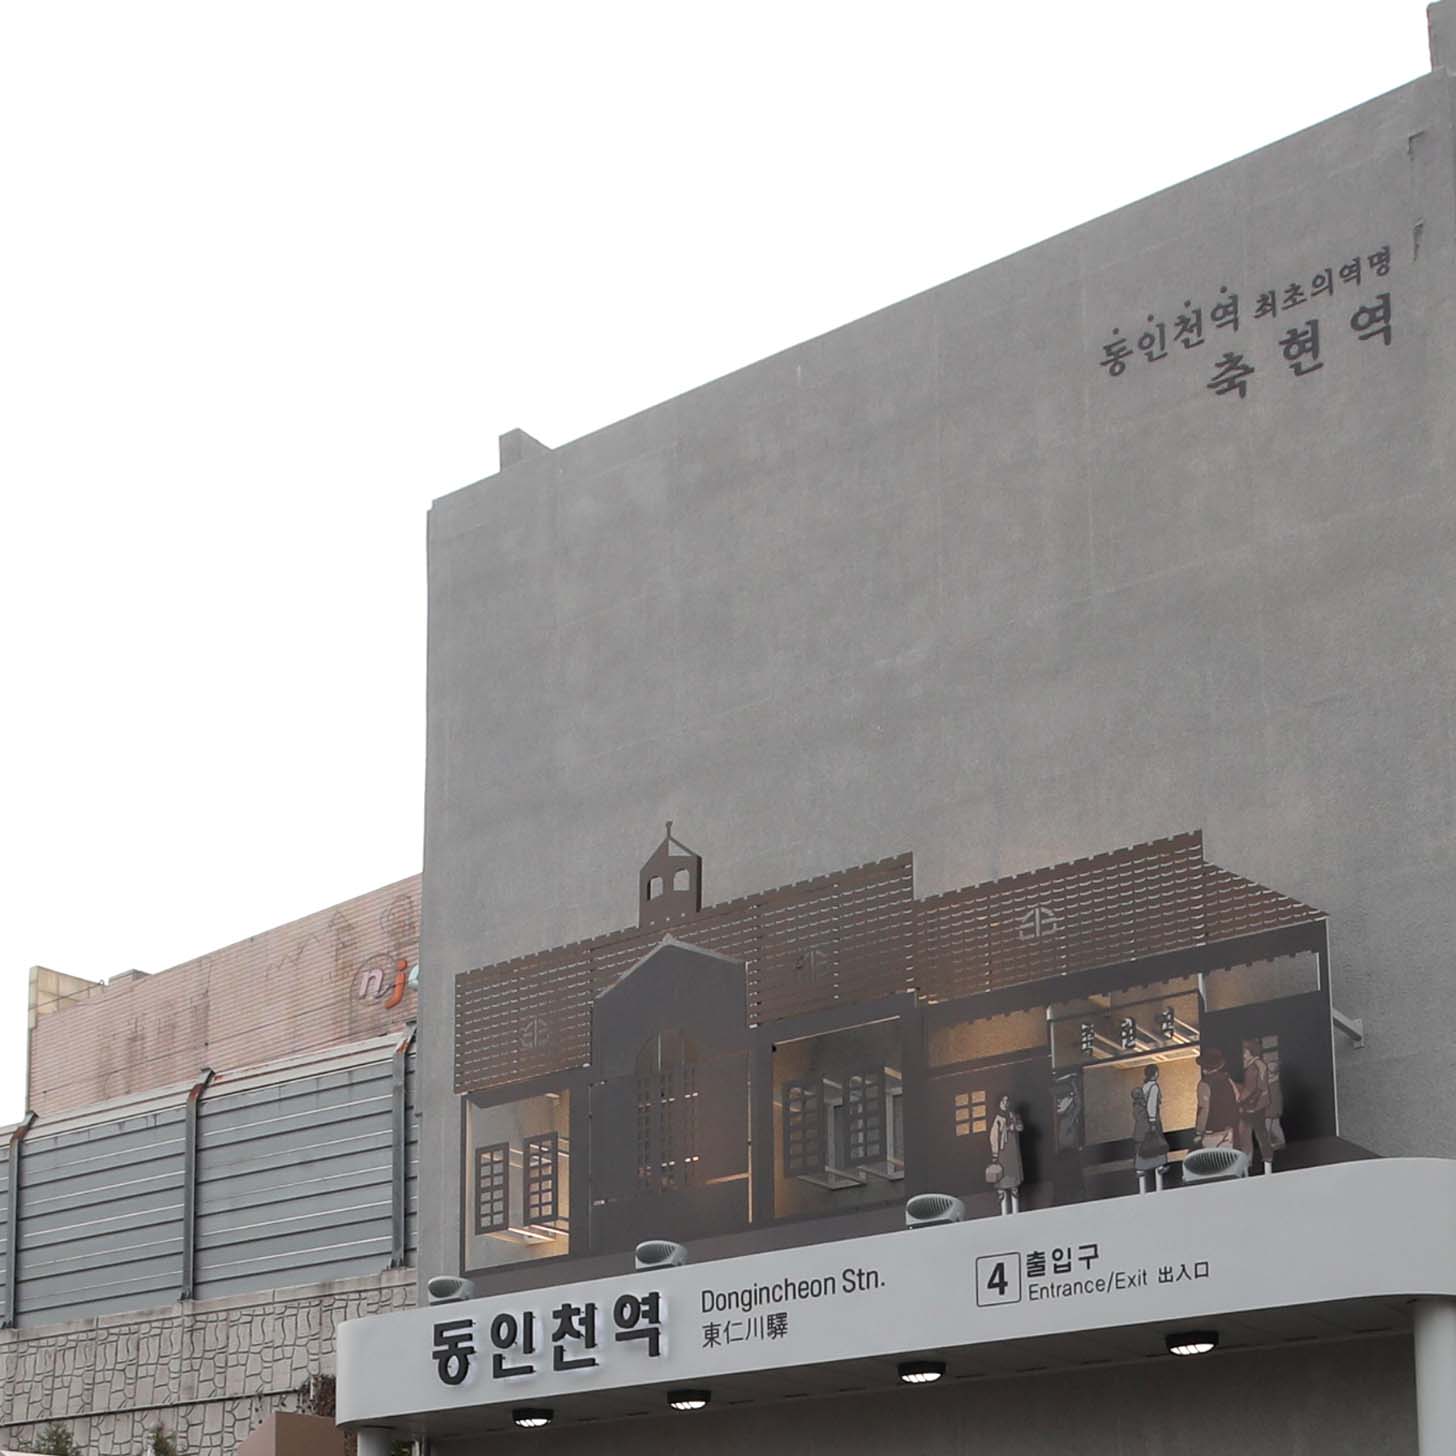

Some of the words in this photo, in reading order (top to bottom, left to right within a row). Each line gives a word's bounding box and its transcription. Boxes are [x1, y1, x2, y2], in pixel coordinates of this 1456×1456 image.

[1100, 284, 1240, 376] 동인천역
[1206, 292, 1392, 399] 축현역
[1026, 1243, 1101, 1278] 출입구
[1158, 1261, 1210, 1285] 出入口
[701, 1279, 837, 1313] Dongincheon
[841, 1267, 886, 1294] Stn.
[987, 1262, 1009, 1296] 4
[1029, 1270, 1148, 1302] Entrance/Exit
[431, 1291, 662, 1386] 동인천역
[701, 1312, 789, 1348] 東仁川驛
